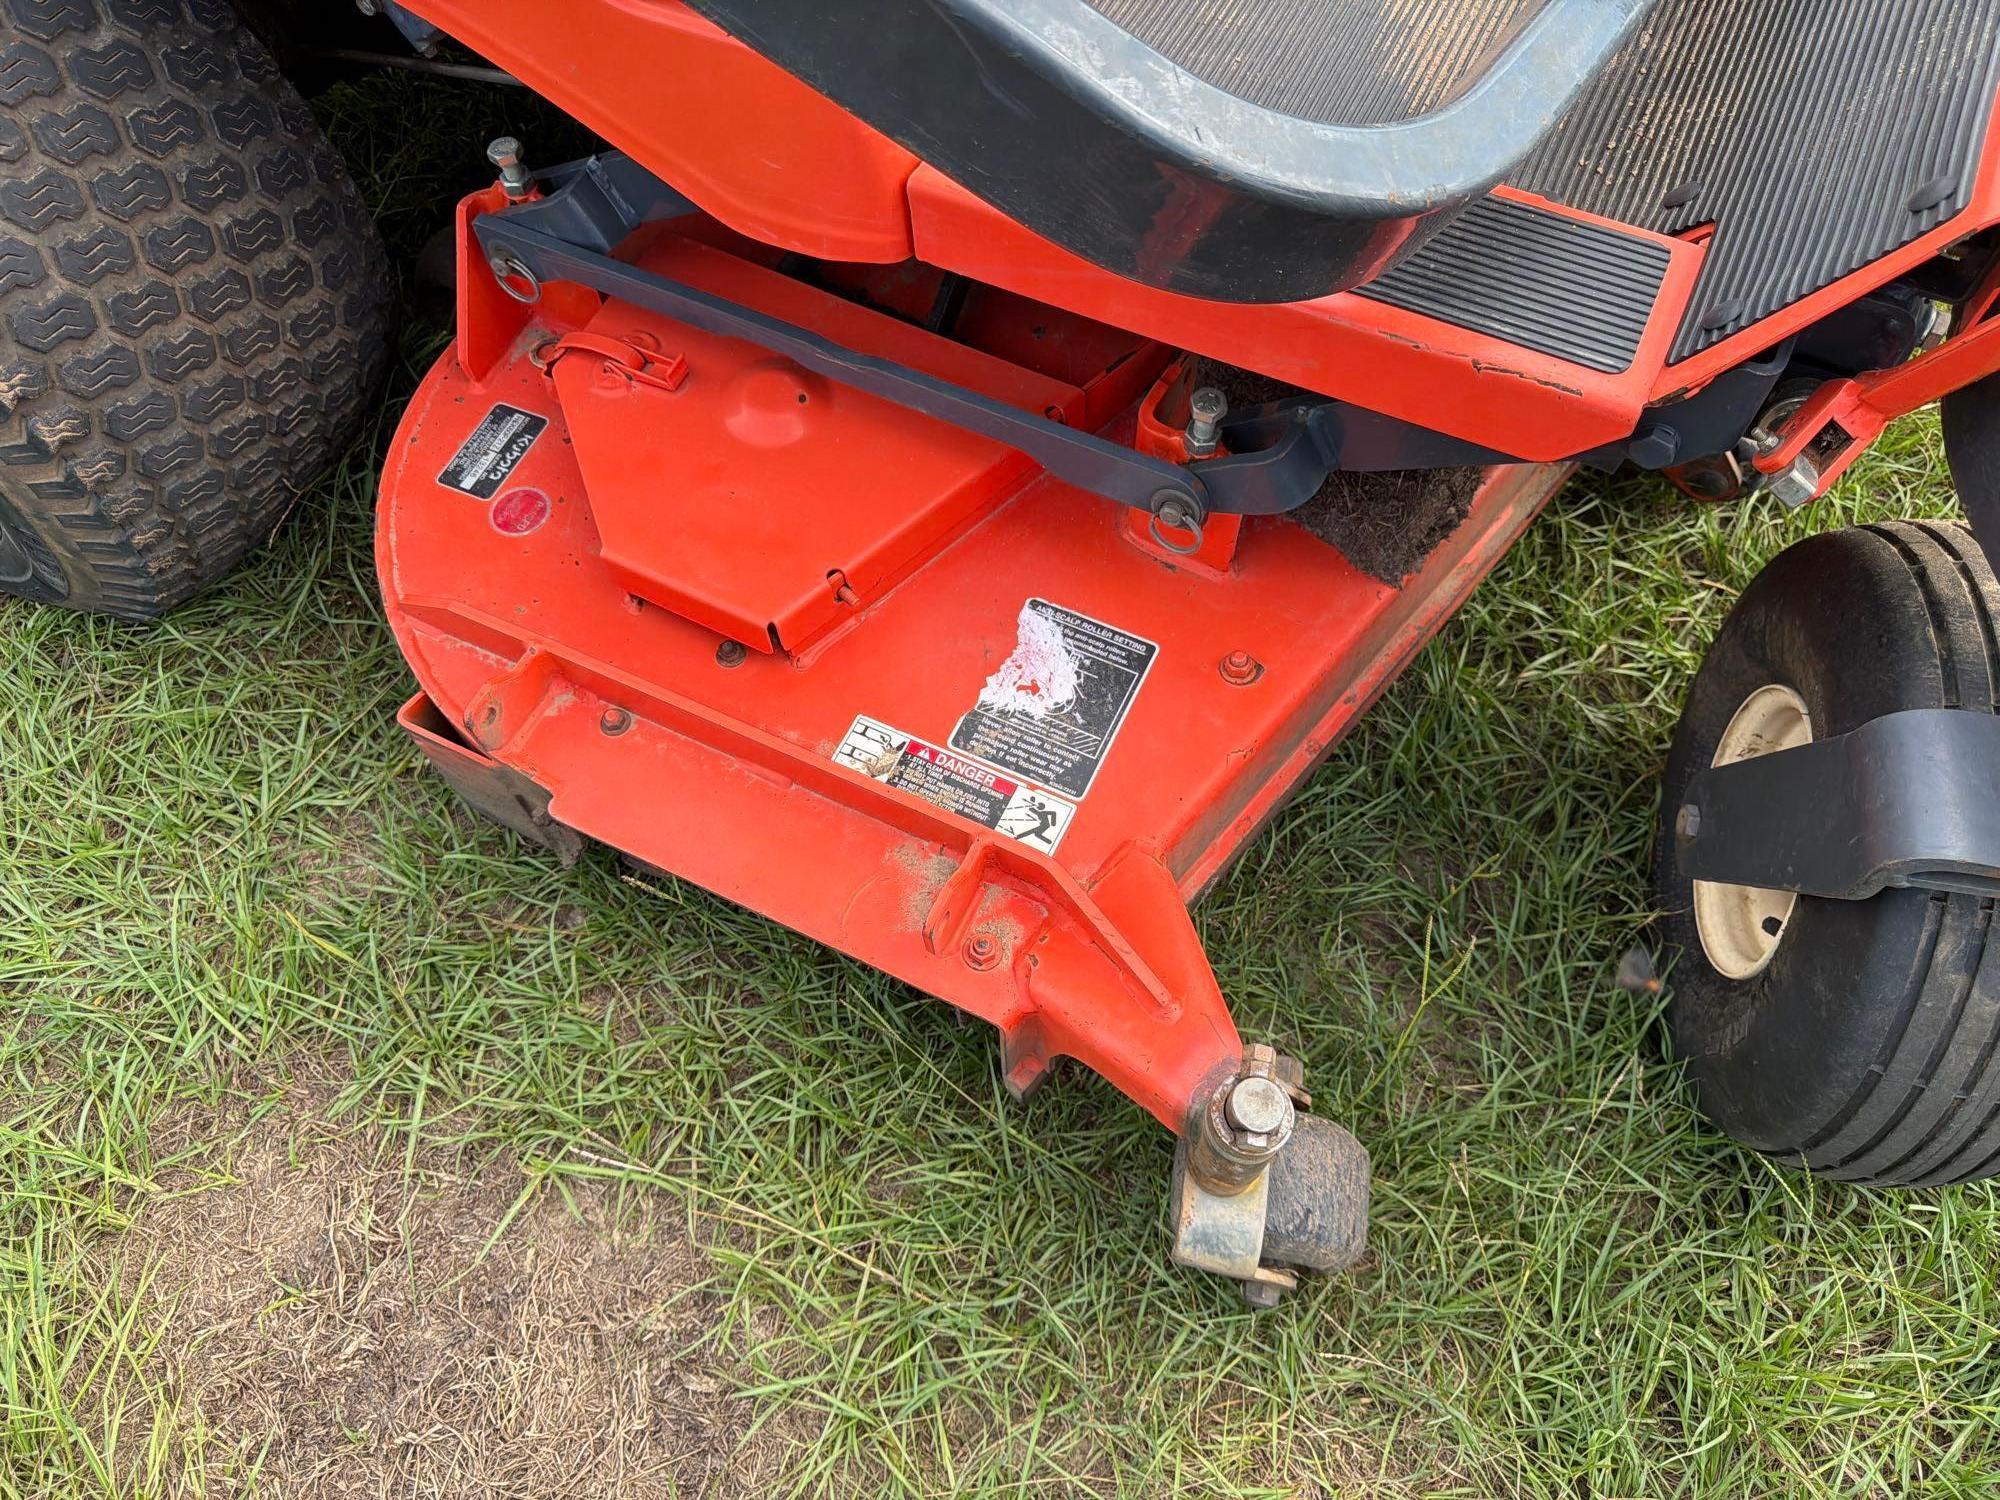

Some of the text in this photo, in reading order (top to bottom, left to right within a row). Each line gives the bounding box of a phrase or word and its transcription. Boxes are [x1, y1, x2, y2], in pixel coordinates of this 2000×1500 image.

[515, 417, 530, 433] MODEL
[489, 433, 533, 482] Kubota
[1035, 605, 1147, 651] ANTI-SCALP ROLLER SETTING
[1074, 634, 1105, 648] anti-scalp
[1108, 654, 1129, 665] below.
[981, 717, 1002, 729] Never
[1003, 726, 1022, 737] allow
[1023, 734, 1042, 746] roller
[1043, 742, 1051, 750] to
[1053, 746, 1080, 761] contact
[973, 732, 1064, 774] premature roller wear may
[1016, 741, 1062, 764] continuously
[927, 770, 943, 779] TIMES
[935, 753, 996, 786] DANGER
[1005, 754, 1017, 763] set
[1018, 759, 1058, 780] incorrectly.
[923, 783, 939, 792] WHEN
[926, 763, 942, 773] CLEAR
[951, 773, 980, 788] DISCHARGE
[981, 786, 1004, 799] OPENING
[937, 781, 954, 792] HANDS
[963, 792, 976, 801] FEET
[976, 798, 989, 807] INTO
[908, 783, 918, 791] NOT
[942, 798, 962, 810] MOWER
[963, 807, 987, 820] WITHOUT
